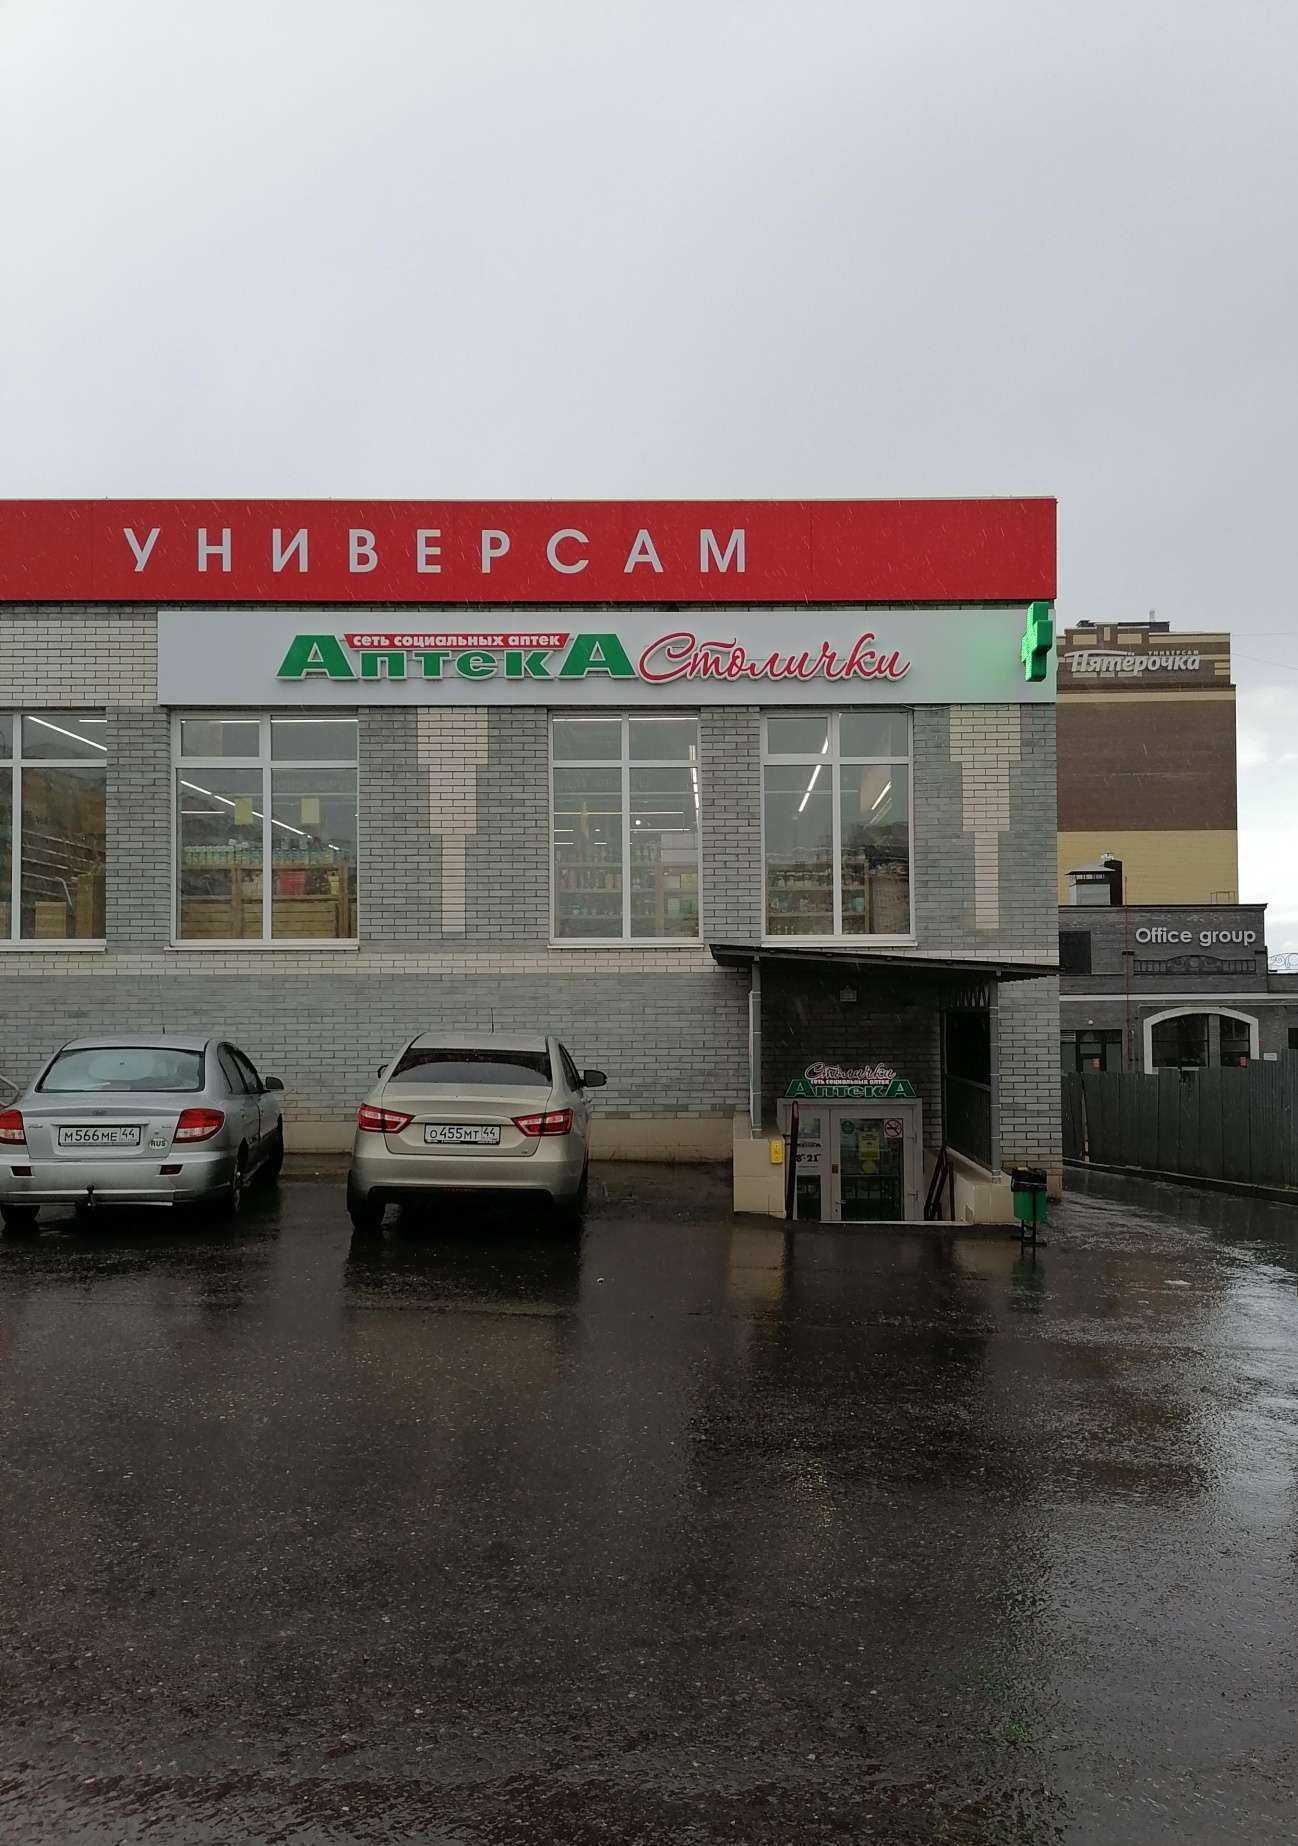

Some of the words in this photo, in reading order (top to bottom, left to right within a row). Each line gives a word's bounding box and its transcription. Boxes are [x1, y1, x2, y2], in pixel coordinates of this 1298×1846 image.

[123, 528, 746, 574] УНИВЕРСАМ
[353, 635, 389, 646] сеть
[394, 635, 503, 648] социальных
[508, 635, 560, 647] аптек
[638, 631, 911, 684] Столички
[1064, 650, 1200, 677] Пятёрочка
[1135, 927, 1193, 943] Office
[1199, 930, 1256, 947] group
[121, 1128, 135, 1139] 44
[483, 1127, 496, 1137] 44
[150, 1139, 166, 1147] RUS
